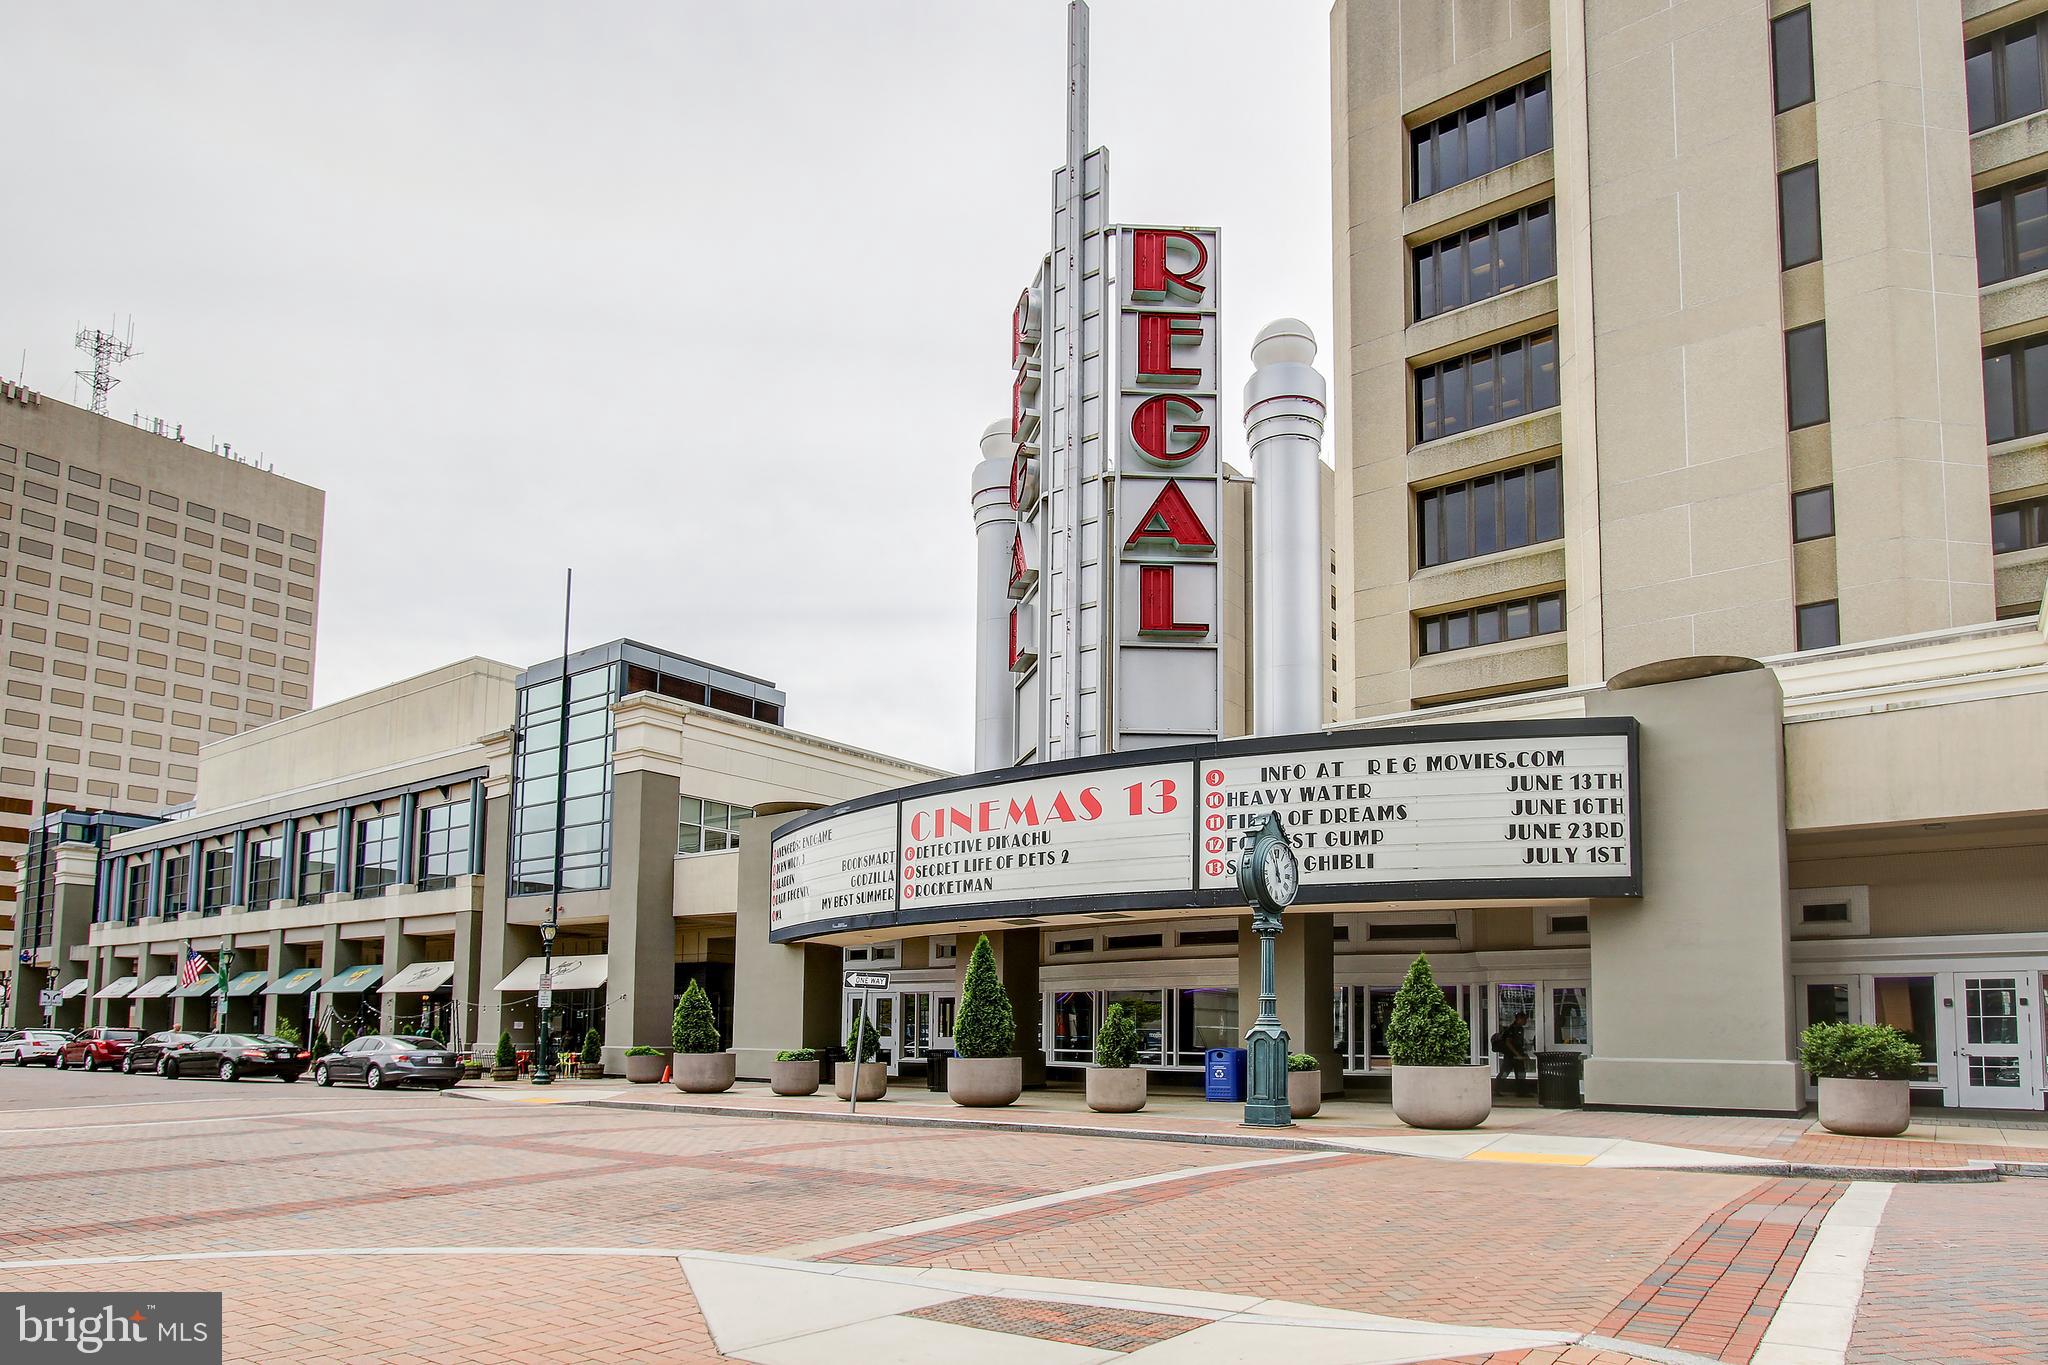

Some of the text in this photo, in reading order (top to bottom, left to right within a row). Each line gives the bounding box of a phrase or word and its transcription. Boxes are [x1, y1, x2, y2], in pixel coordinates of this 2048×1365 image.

[1123, 228, 1216, 638] REGAL
[1261, 764, 1306, 783] INFO
[1316, 761, 1344, 778] AT
[1426, 750, 1565, 772] MOVIES.COM
[1506, 773, 1623, 792] JUNE 13TH
[1208, 783, 1372, 807] 10 HEAVY WATER
[911, 779, 1178, 842] CINEMAS 13
[1208, 816, 1221, 829] 11
[1288, 809, 1313, 826] OF
[1320, 804, 1408, 825] DREAMS
[1511, 798, 1624, 816] JUNE 16TH
[1208, 839, 1222, 851] 12
[1324, 829, 1384, 847] GUMP
[1504, 822, 1624, 840] JUNE 23RD
[916, 838, 982, 859] DETECTIVE
[987, 830, 1051, 851] PIKACHU
[1522, 846, 1624, 864] JULY 1ST
[841, 851, 895, 871] BOOKSMART
[915, 860, 959, 879] SECRET
[964, 857, 992, 873] LIFE
[996, 855, 1013, 870] OF
[1018, 850, 1056, 867] PETS
[1061, 849, 1069, 864] 2
[1208, 861, 1222, 874] 13
[1304, 853, 1374, 872] GHIBLI
[850, 869, 895, 887] GODZILLA
[915, 877, 993, 898] ROCKETMAN
[822, 888, 894, 910] MY BEST SUMMER
[856, 976, 885, 985] ONE WAY
